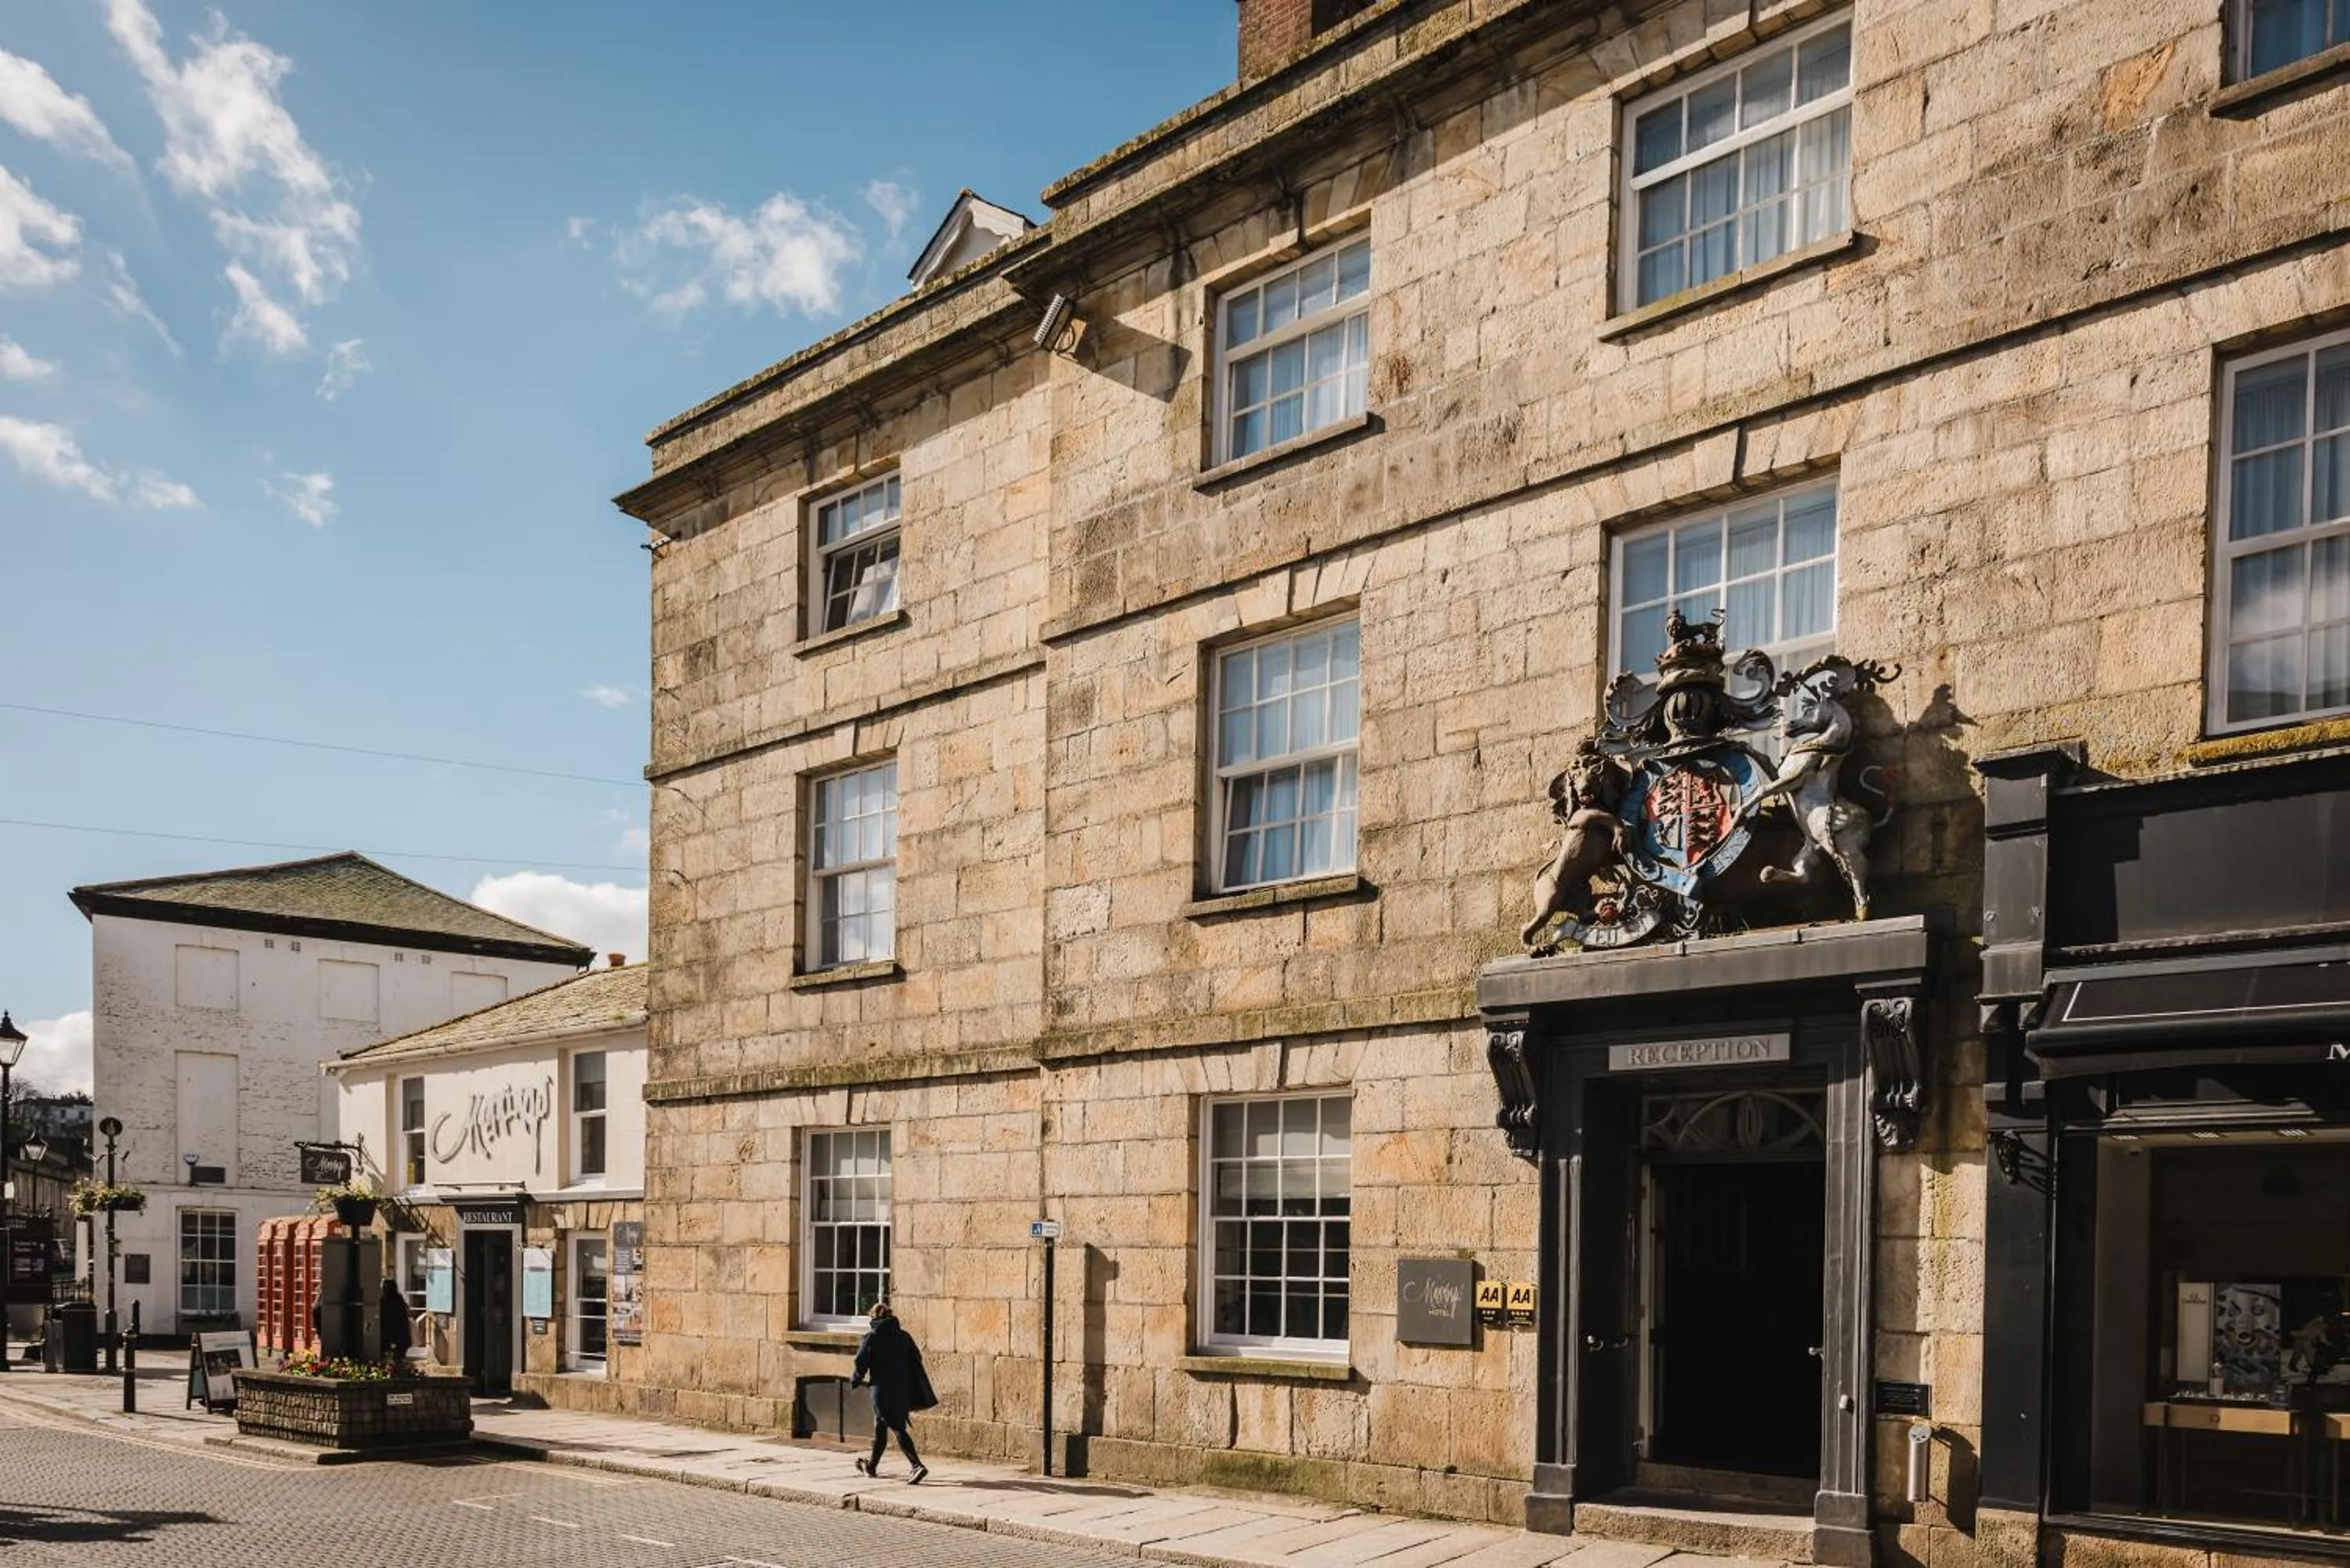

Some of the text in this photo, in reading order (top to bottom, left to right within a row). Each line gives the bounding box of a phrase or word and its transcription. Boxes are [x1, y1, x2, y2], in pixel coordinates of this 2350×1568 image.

[1627, 1039, 1771, 1065] RECEPTION
[1480, 1287, 1499, 1302] AA
[1511, 1288, 1531, 1303] AA
